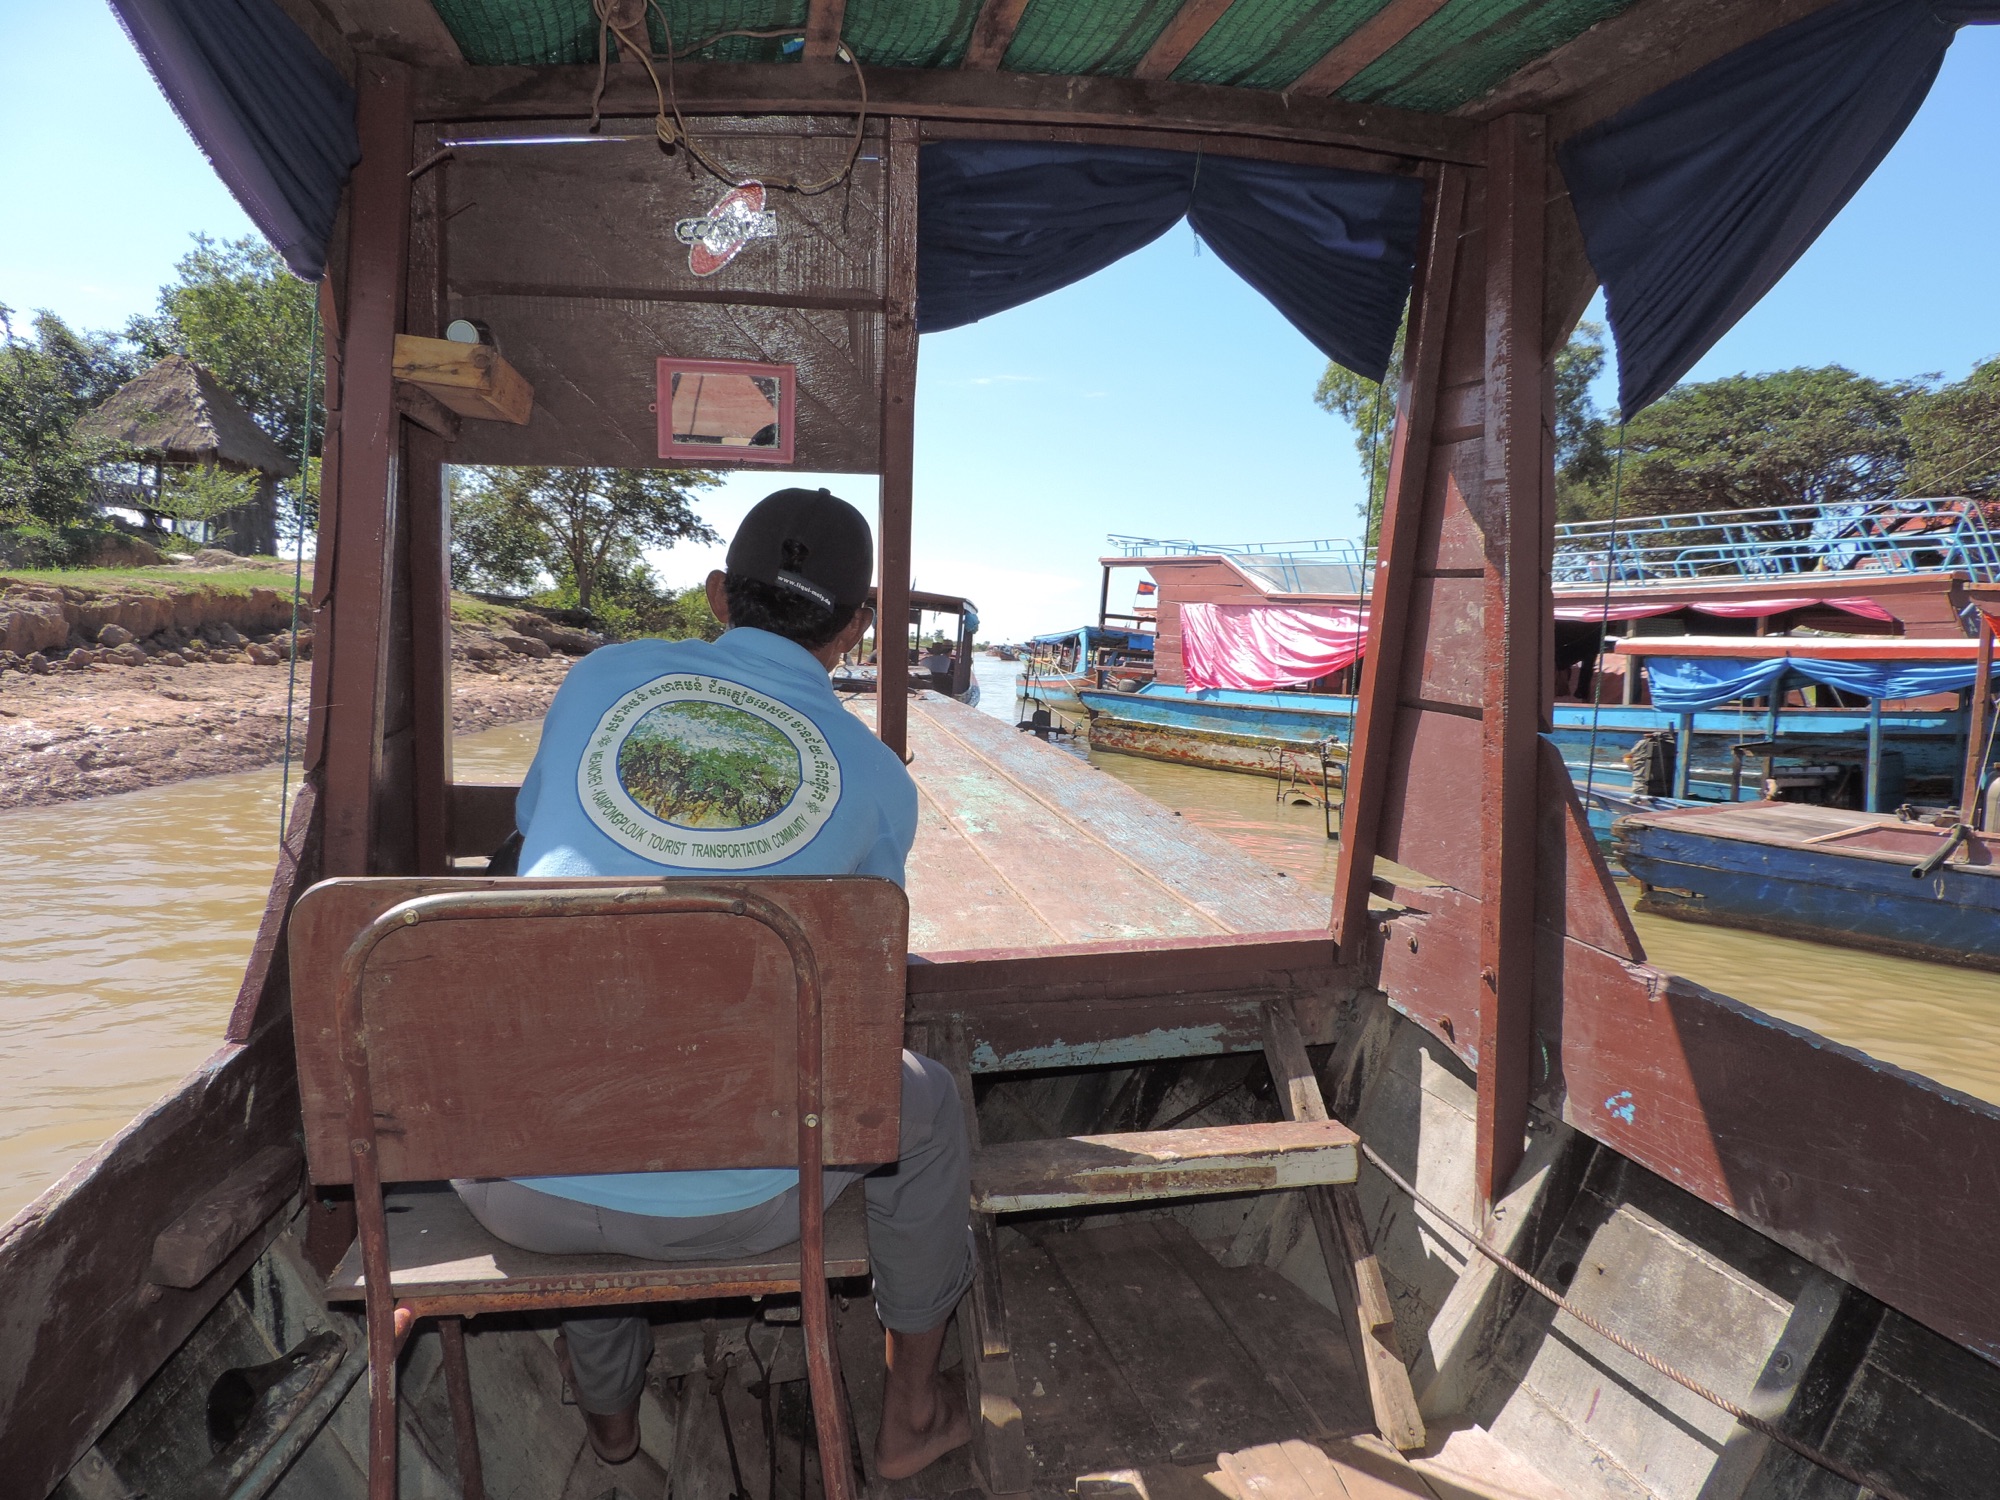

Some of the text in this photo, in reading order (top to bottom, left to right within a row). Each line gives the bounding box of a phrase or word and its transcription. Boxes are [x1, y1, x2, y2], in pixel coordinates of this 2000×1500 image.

[587, 751, 810, 858] MEANCHEY KAMPONGPLOUK TOURIST TRANSPORTATION COMMUNITY
